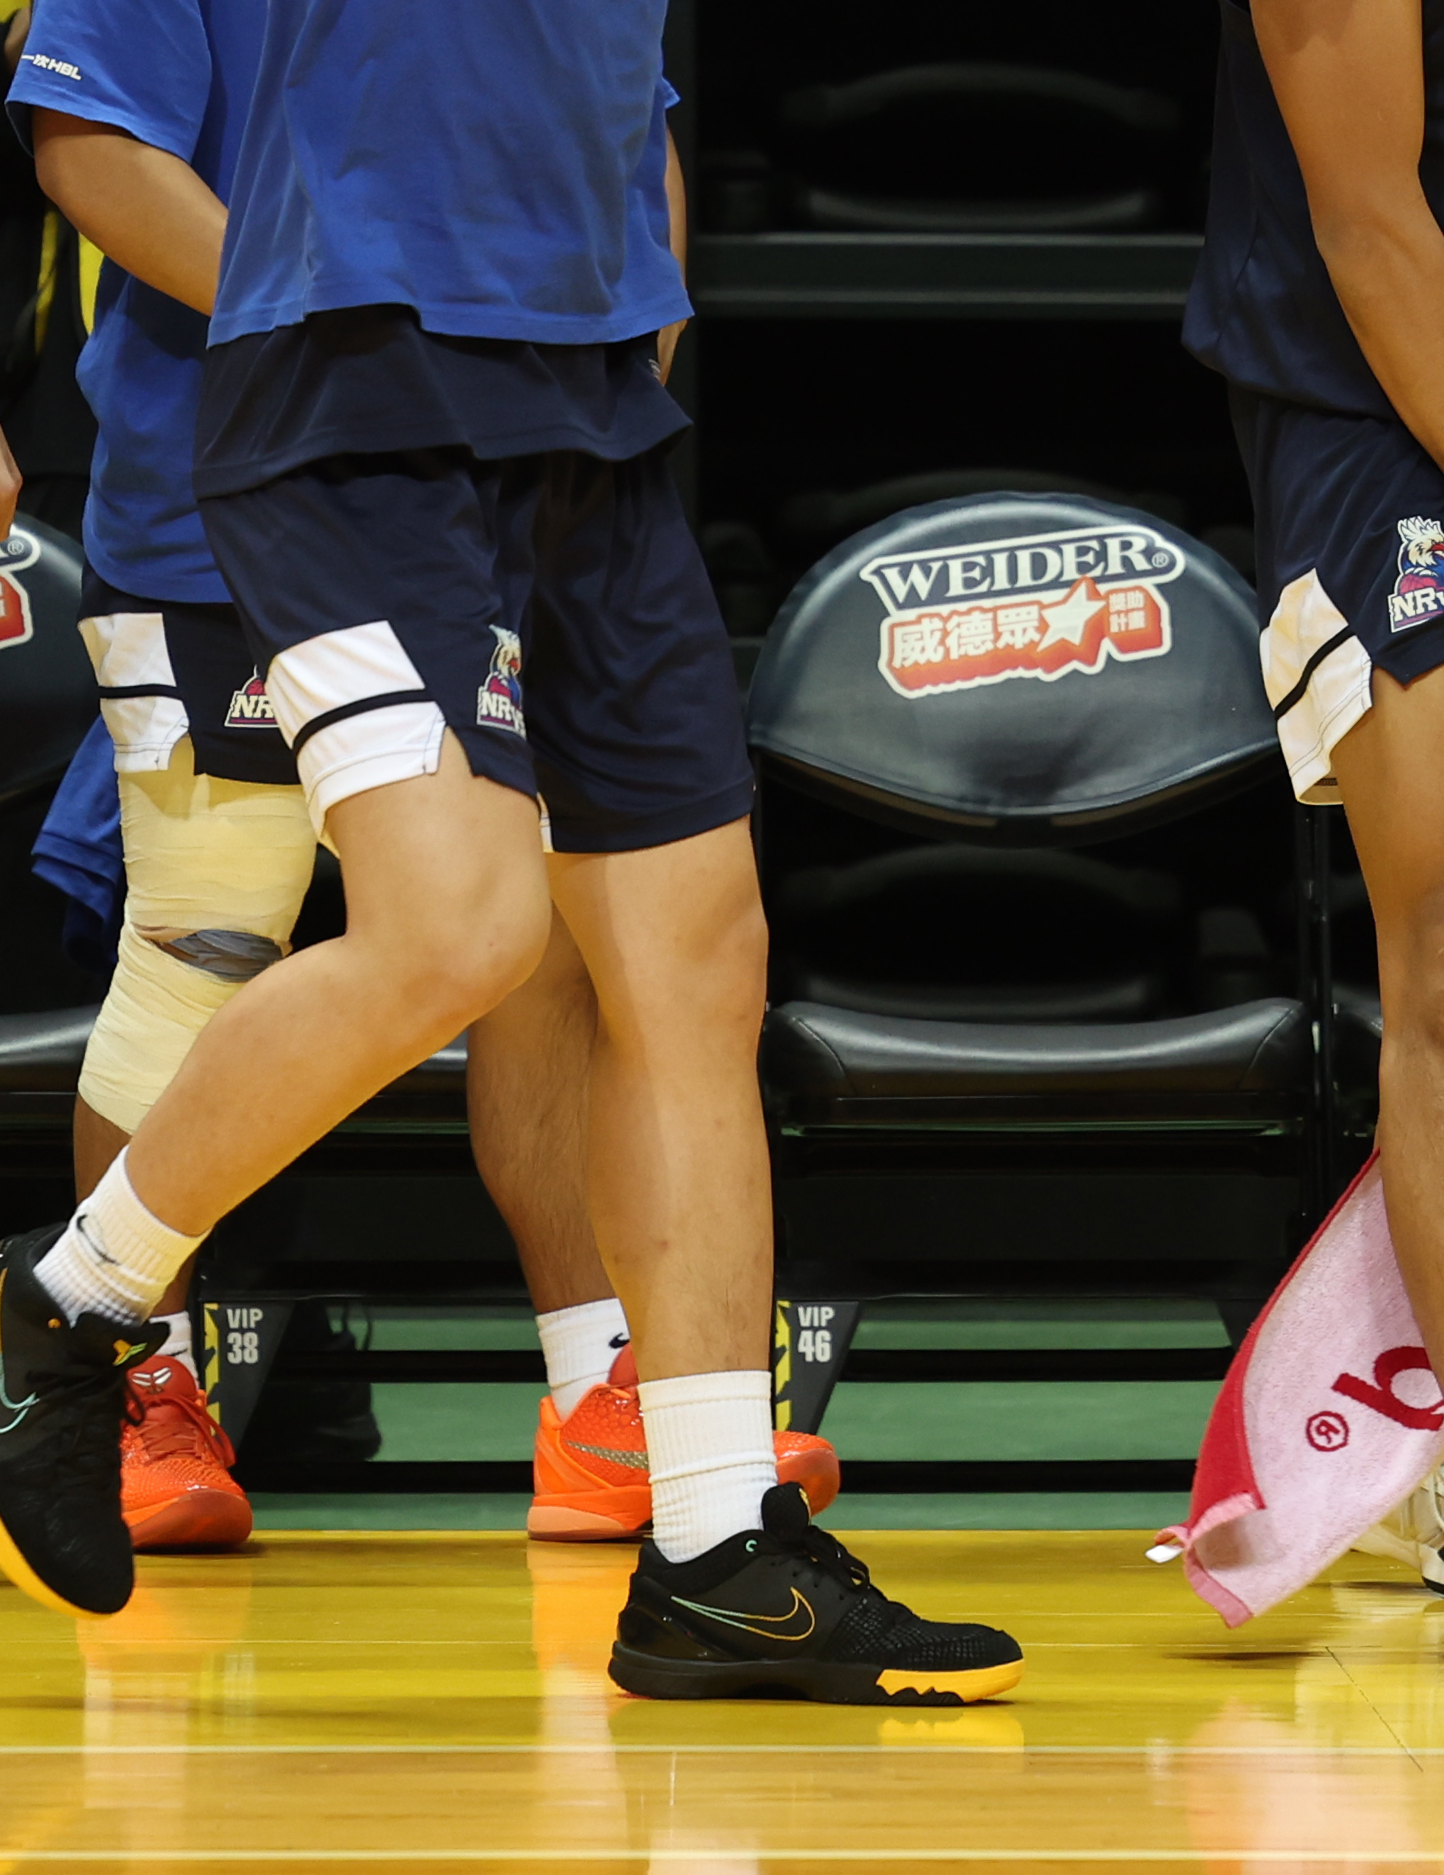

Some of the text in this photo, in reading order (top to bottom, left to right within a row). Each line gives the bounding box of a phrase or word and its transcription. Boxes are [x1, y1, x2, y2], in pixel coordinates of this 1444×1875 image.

[881, 535, 1153, 605] WEIDER
[891, 604, 1043, 670] 威德眾
[233, 695, 274, 719] NR
[226, 1308, 263, 1329] VIP
[798, 1306, 834, 1327] VIP
[227, 1332, 258, 1364] 38
[798, 1330, 831, 1362] 46
